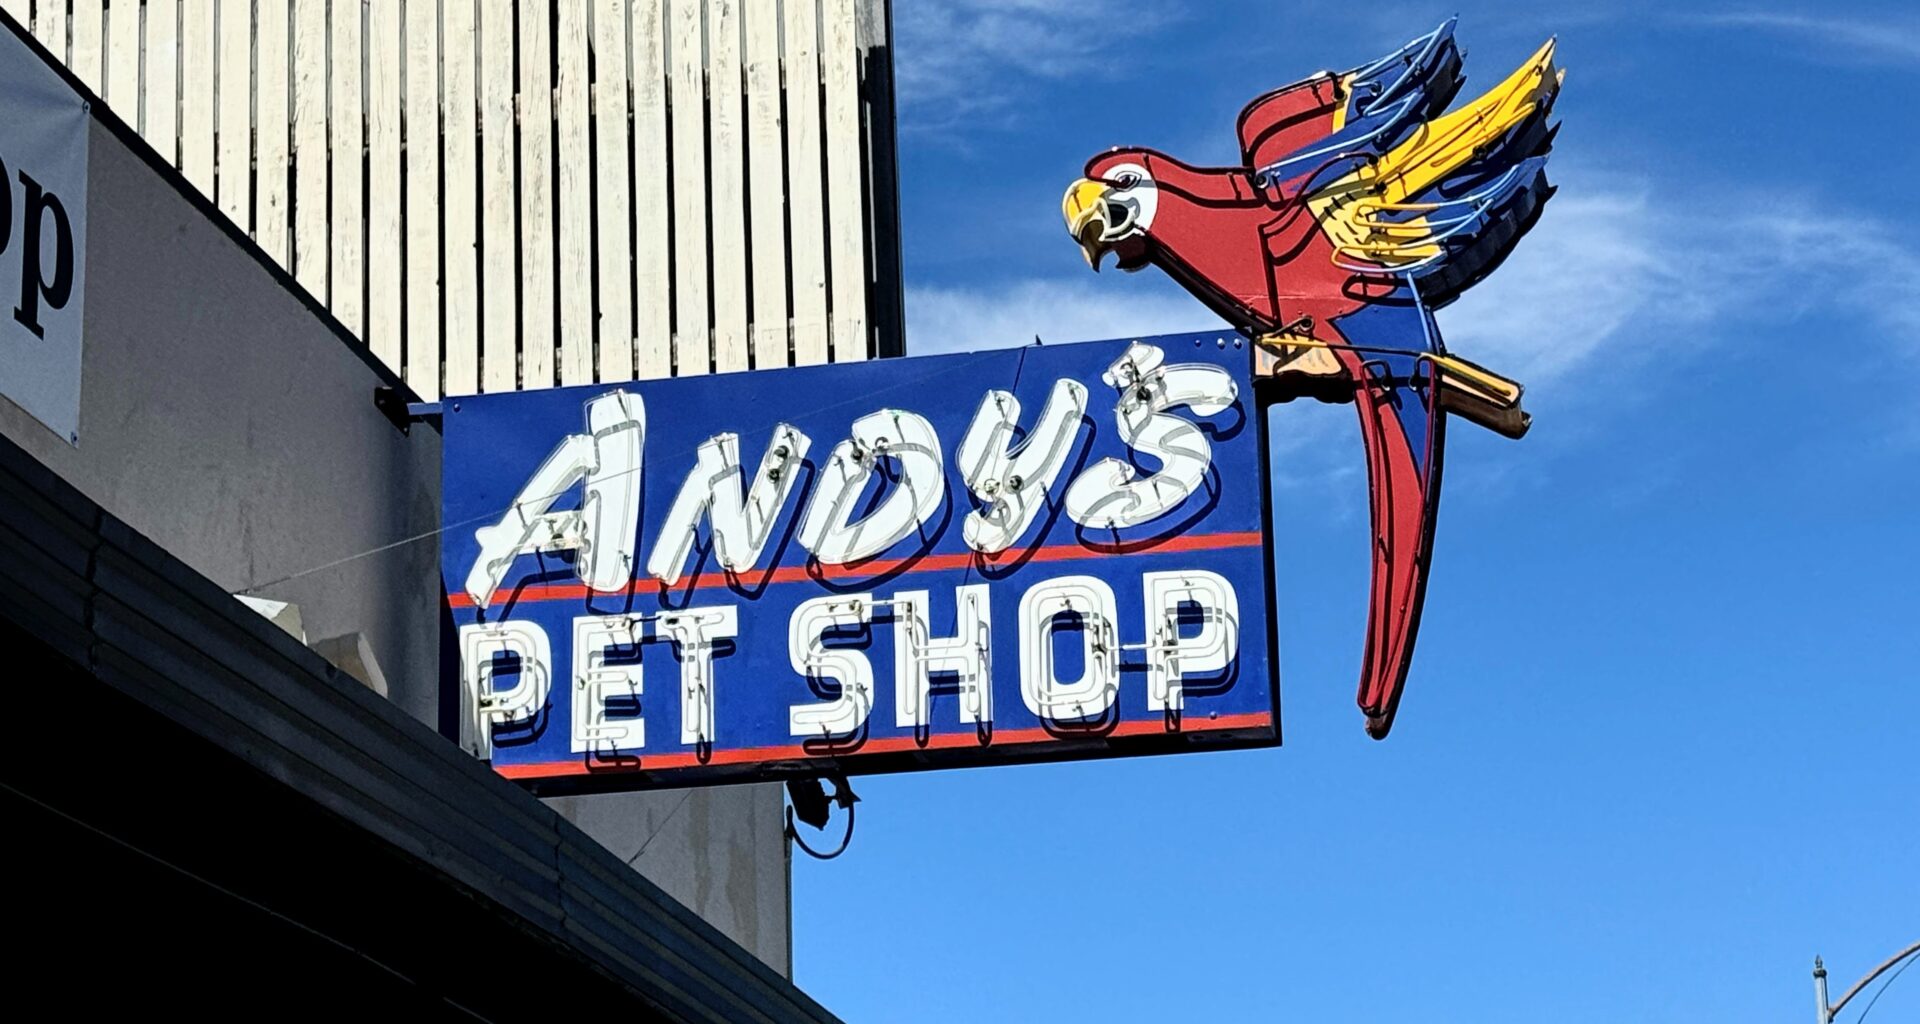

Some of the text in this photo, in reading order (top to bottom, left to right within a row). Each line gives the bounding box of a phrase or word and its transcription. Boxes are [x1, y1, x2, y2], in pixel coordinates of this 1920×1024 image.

[0, 155, 74, 341] p
[465, 342, 1239, 609] ANDY'S
[460, 569, 1239, 760] PET SHOP
